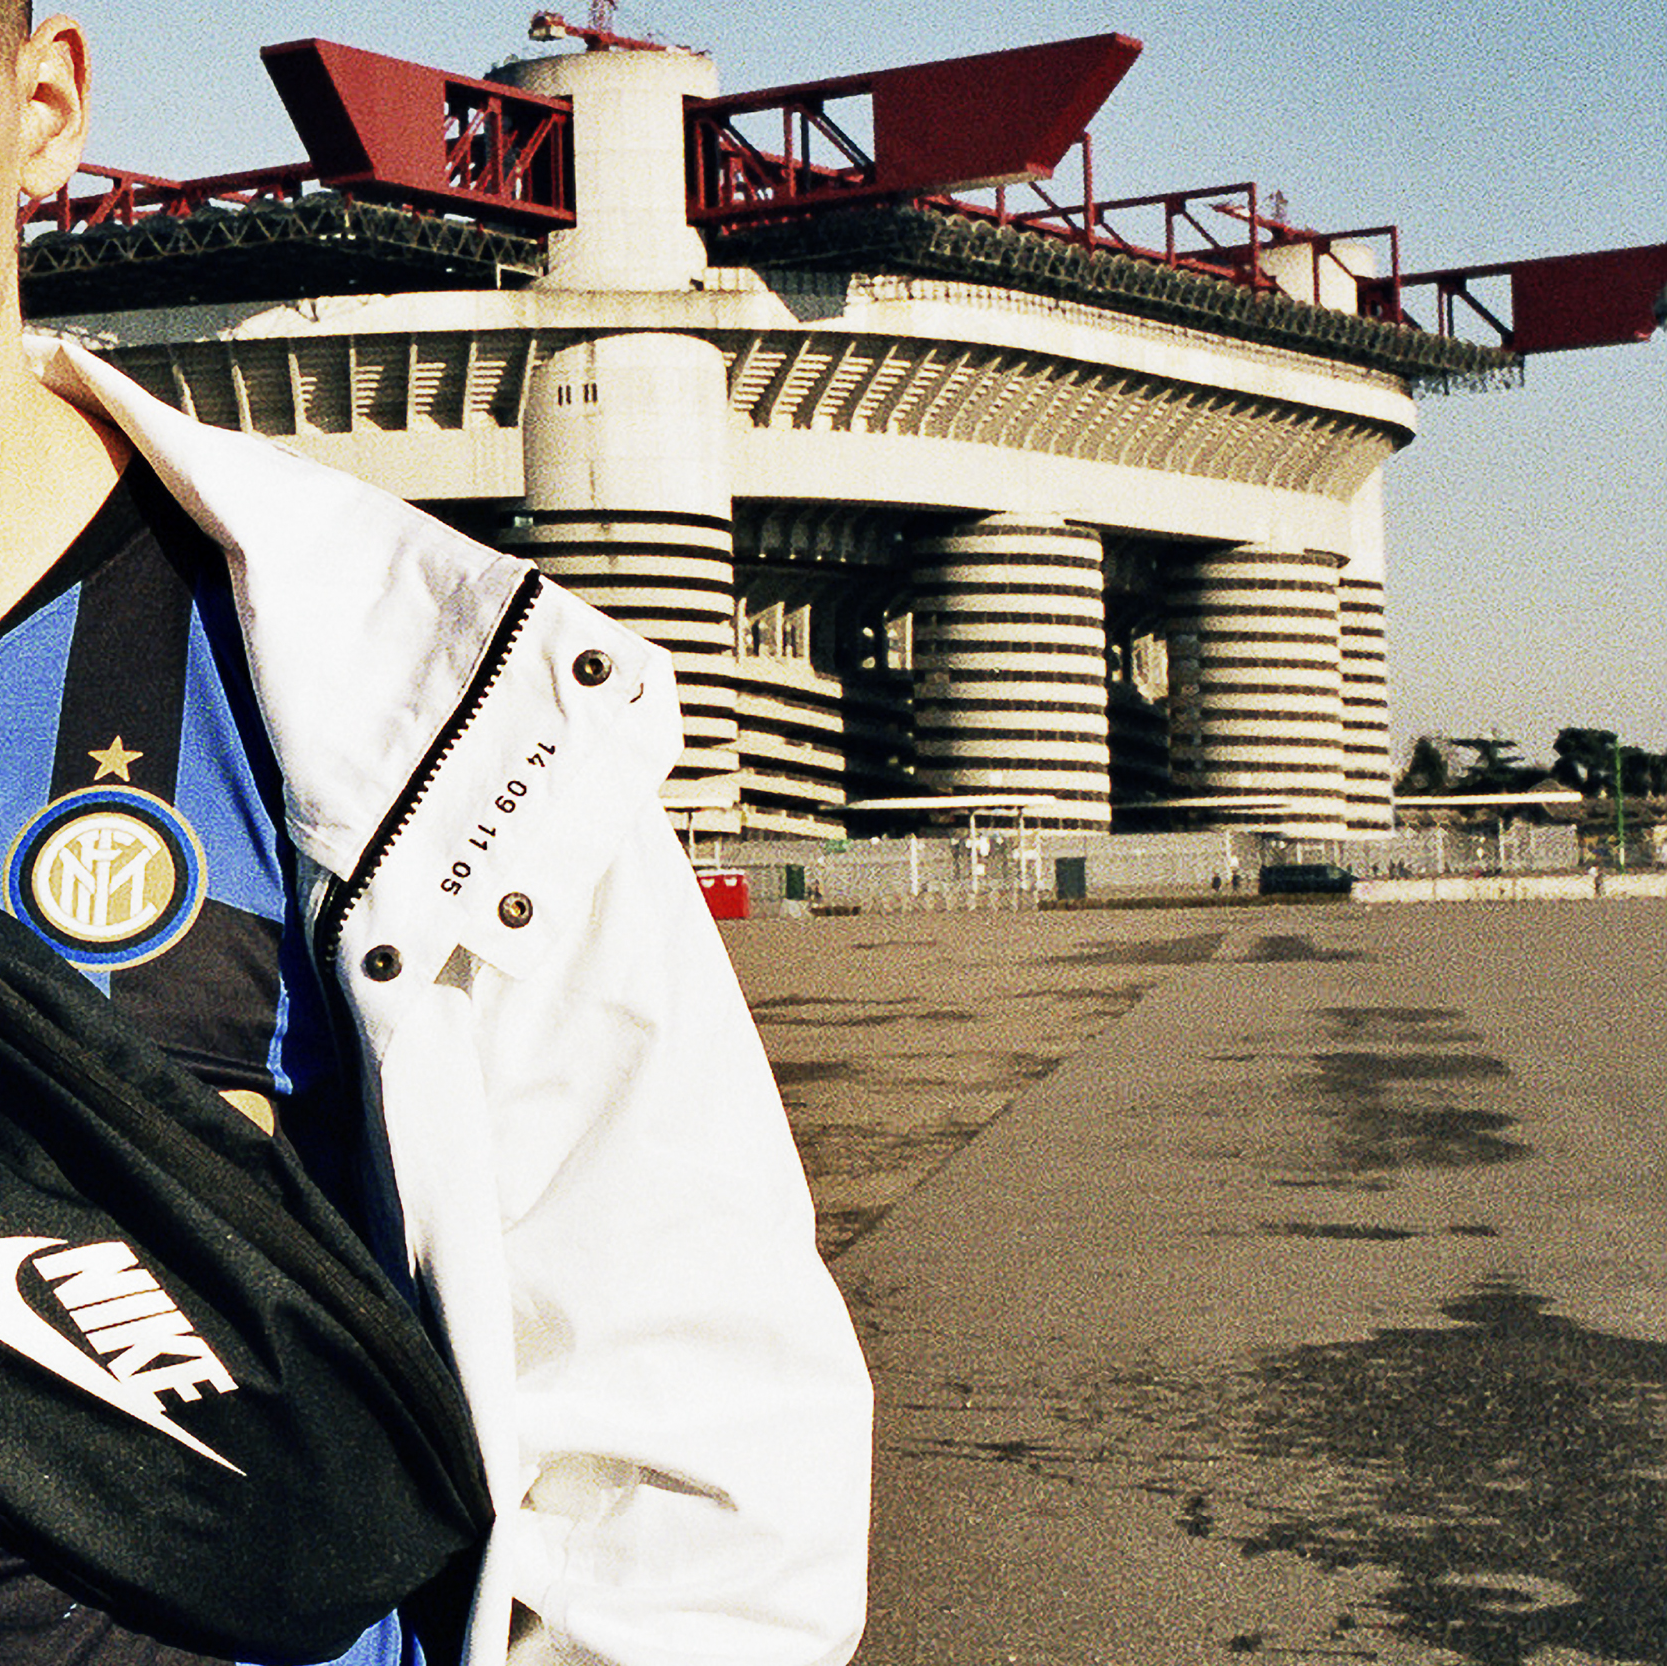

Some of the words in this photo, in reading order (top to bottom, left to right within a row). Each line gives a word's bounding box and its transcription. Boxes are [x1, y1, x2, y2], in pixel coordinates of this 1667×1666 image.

[526, 741, 557, 768] 14
[494, 779, 529, 814] 09
[468, 823, 497, 851] 11
[440, 861, 472, 896] 05
[32, 1240, 240, 1413] NIKE
